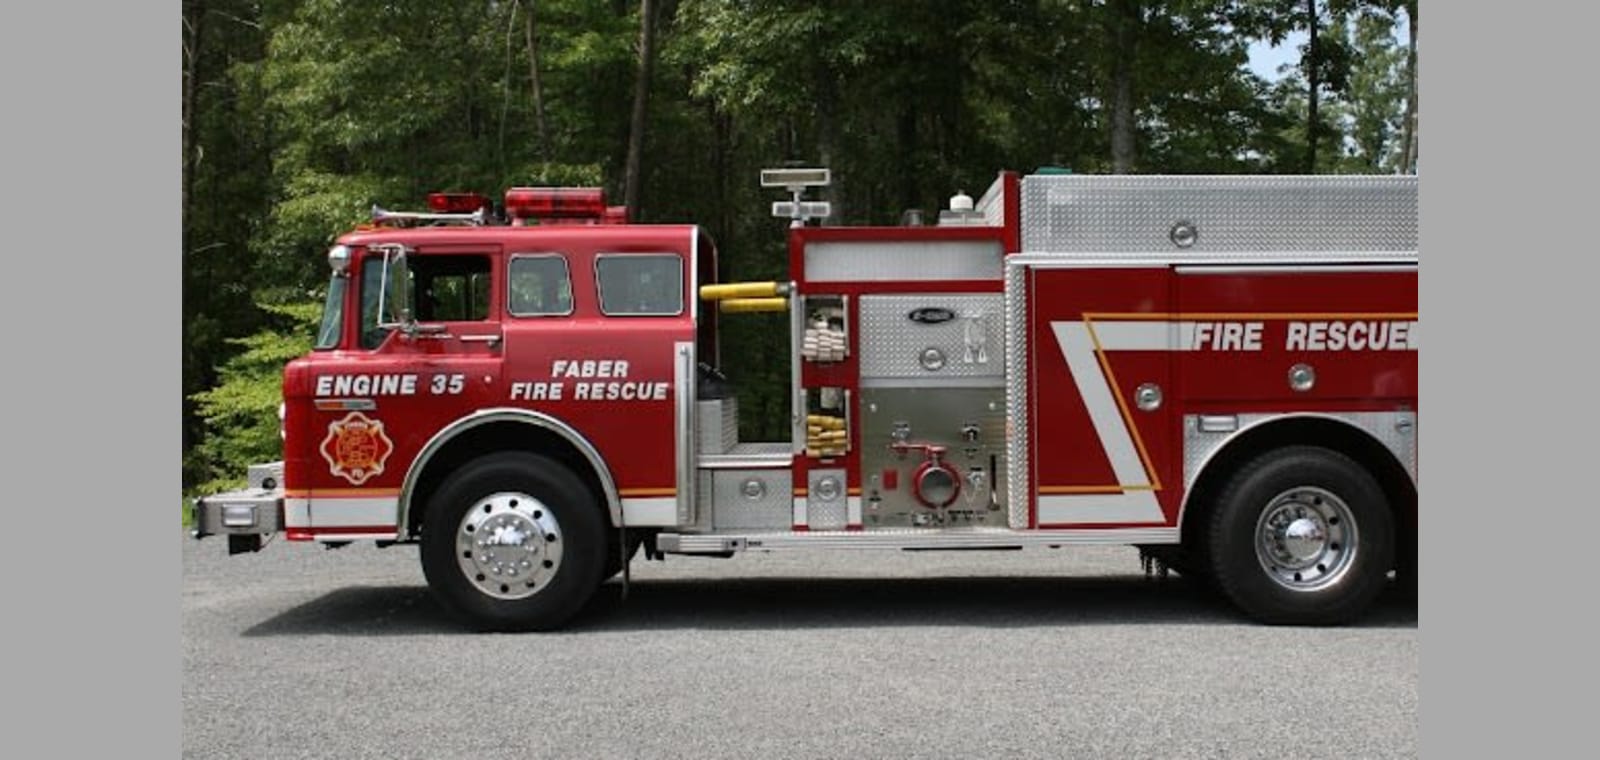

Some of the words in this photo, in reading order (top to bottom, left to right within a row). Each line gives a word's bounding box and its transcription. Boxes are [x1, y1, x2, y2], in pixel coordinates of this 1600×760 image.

[1193, 322, 1264, 350] FIRE
[1286, 321, 1409, 350] RESCUE
[552, 360, 628, 377] FABER
[315, 376, 417, 396] ENGINE
[431, 375, 464, 394] 35
[510, 382, 562, 399] FIRE
[575, 382, 669, 399] RESCUE
